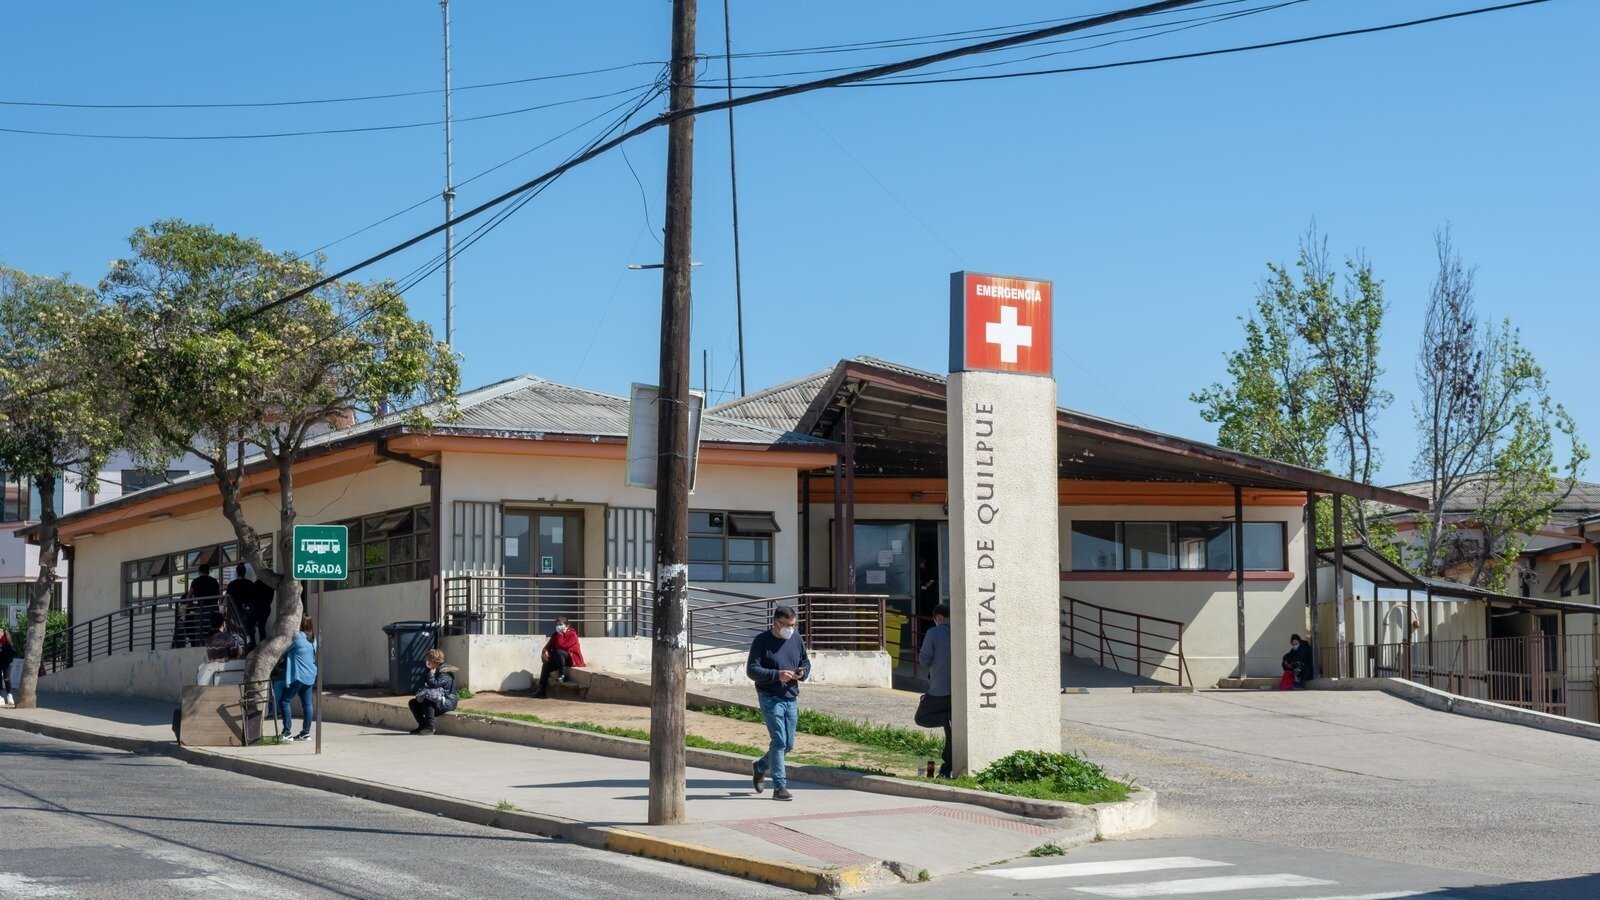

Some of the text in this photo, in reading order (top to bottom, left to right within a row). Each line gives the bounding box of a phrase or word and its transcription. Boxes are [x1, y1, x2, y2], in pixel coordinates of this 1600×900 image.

[976, 284, 1042, 302] EMERGENCIA
[975, 402, 999, 709] HOSPITAL DE QUILPUE
[297, 564, 342, 574] PARADA
